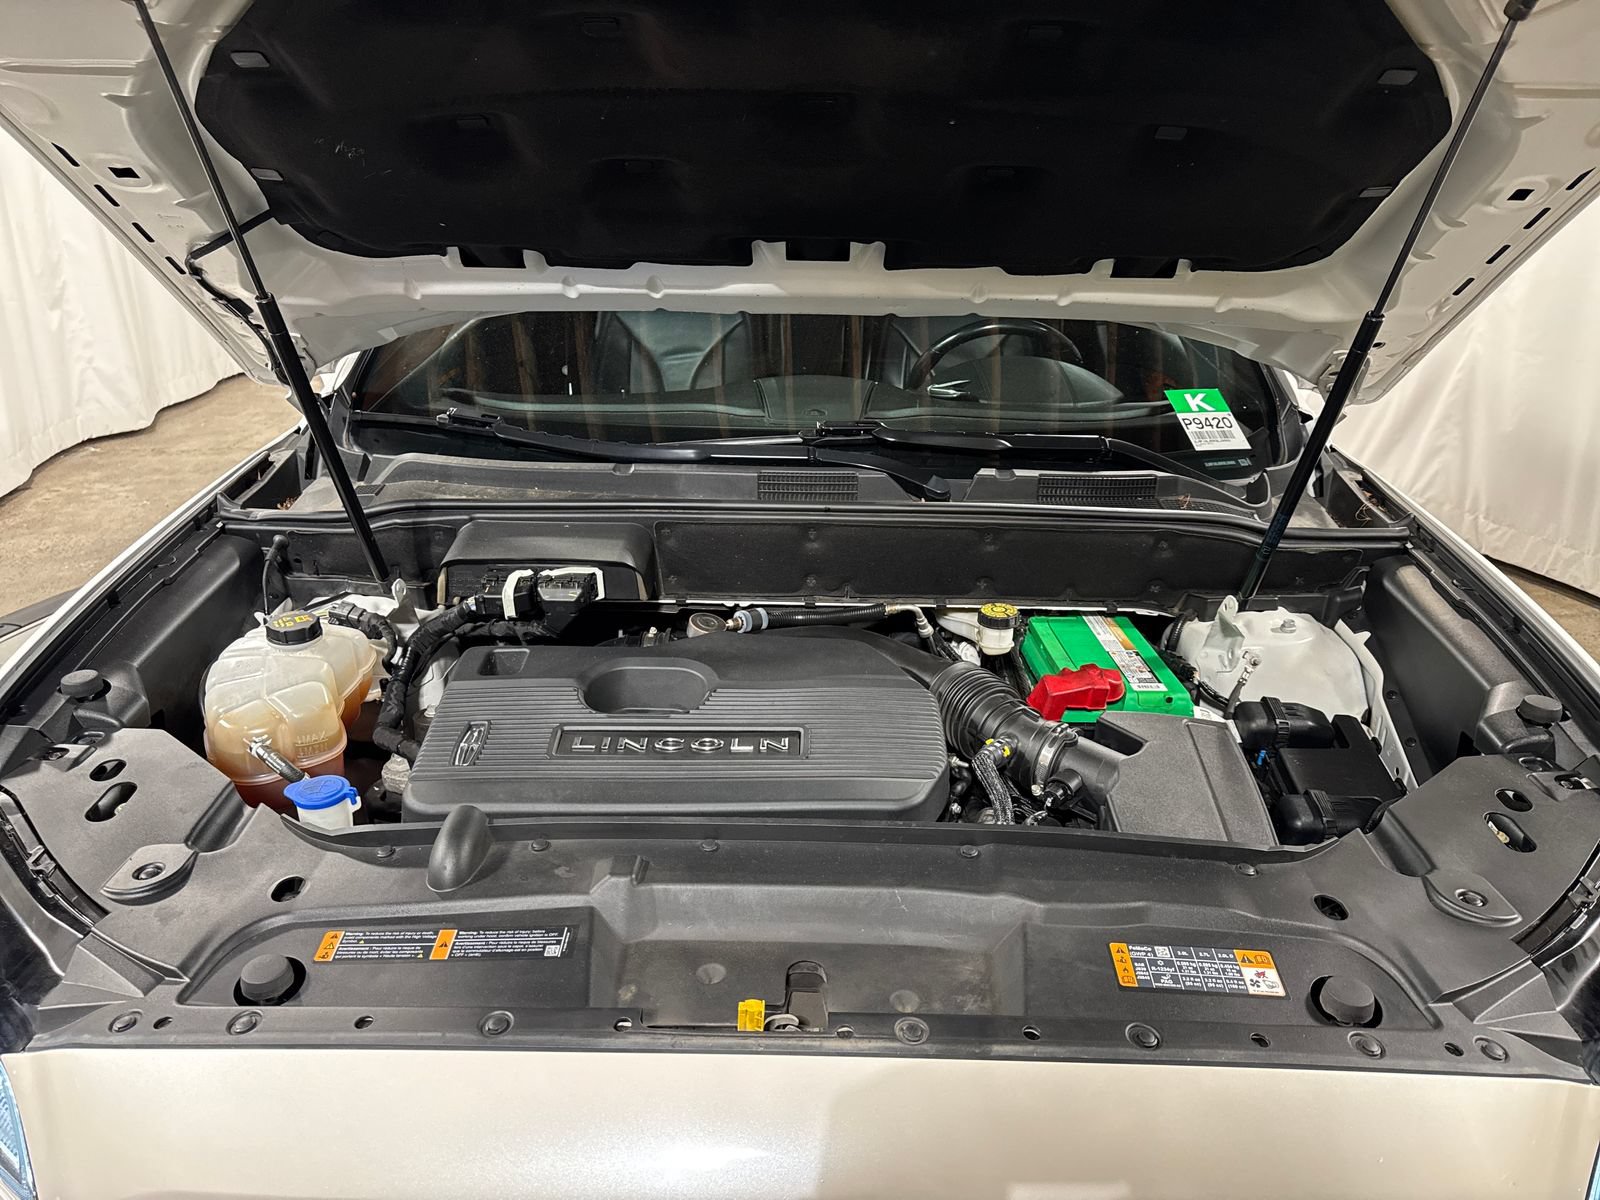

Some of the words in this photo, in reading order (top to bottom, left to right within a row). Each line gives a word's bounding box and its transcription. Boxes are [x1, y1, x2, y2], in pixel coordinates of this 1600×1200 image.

[1184, 393, 1216, 411] K
[1182, 416, 1233, 430] P9420
[571, 736, 789, 752] LINCOLN
